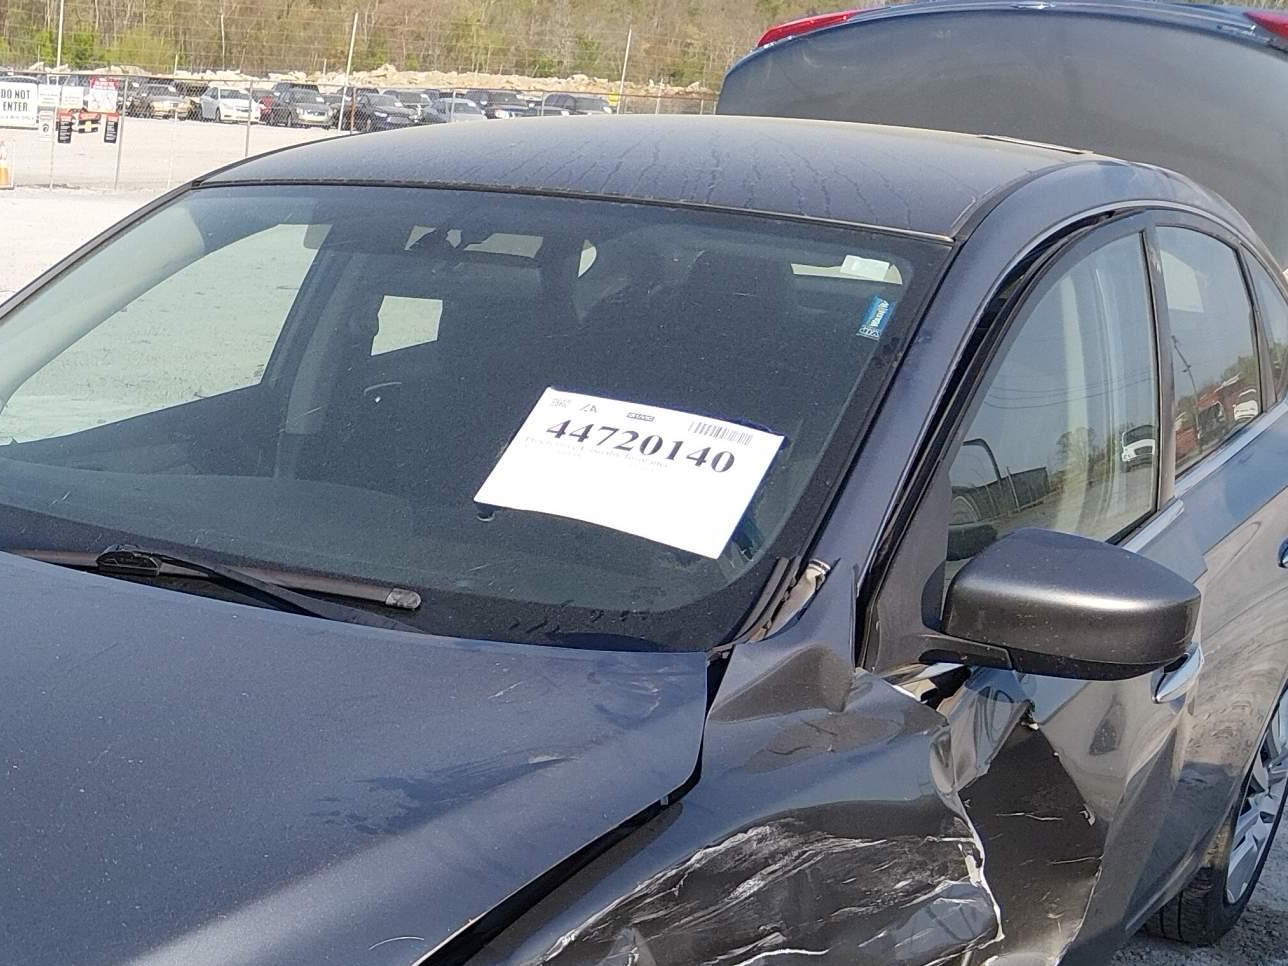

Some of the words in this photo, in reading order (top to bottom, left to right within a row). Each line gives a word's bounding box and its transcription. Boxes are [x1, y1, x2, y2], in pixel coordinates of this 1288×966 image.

[0, 88, 12, 99] DO
[14, 89, 30, 100] NOT
[2, 101, 28, 112] ENTER
[546, 419, 735, 472] 44720140
